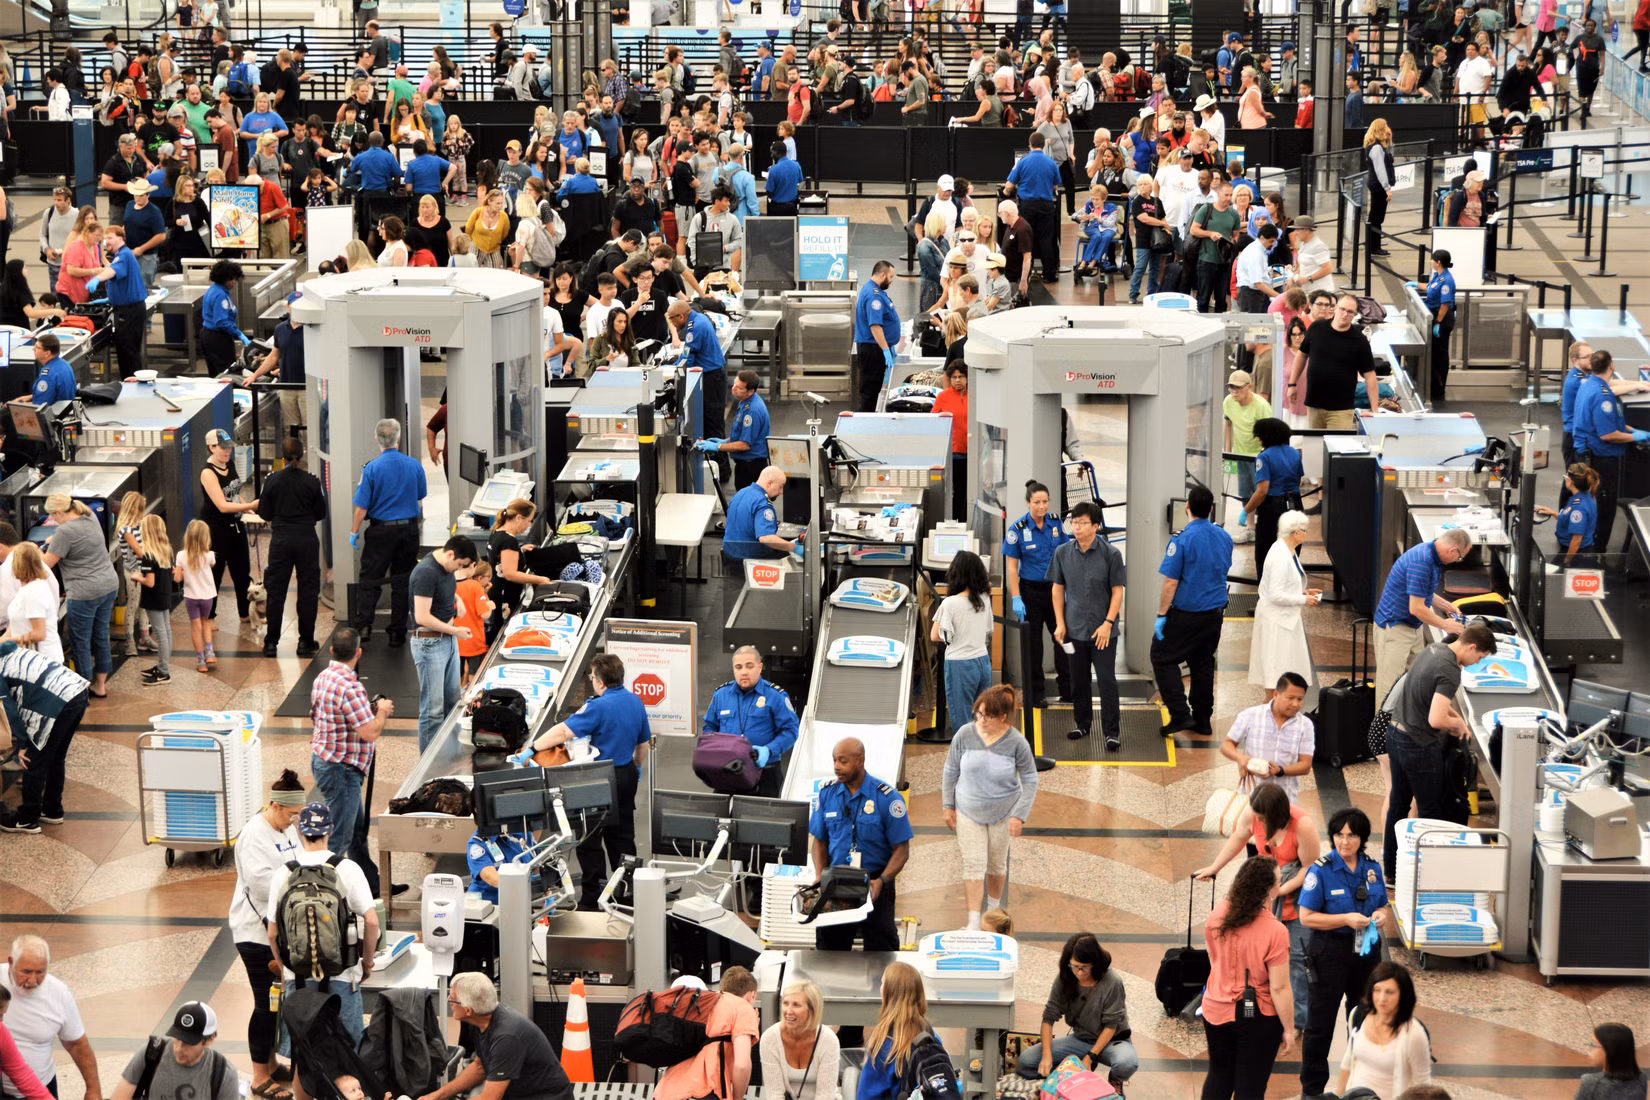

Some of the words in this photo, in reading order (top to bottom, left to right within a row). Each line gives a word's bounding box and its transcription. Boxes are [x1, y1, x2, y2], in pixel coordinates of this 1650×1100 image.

[1446, 167, 1456, 175] TSA
[803, 235, 831, 244] HOLD
[833, 235, 843, 244] IT
[392, 327, 431, 335] ProVision
[414, 335, 431, 343] ATD
[642, 370, 648, 381] 5
[1076, 372, 1116, 380] ProVision
[1097, 380, 1115, 388] ATD
[811, 425, 817, 437] 6
[1528, 431, 1534, 442] 7
[755, 569, 778, 578] STOP
[1575, 579, 1598, 588] STOP
[634, 683, 664, 696] STOP
